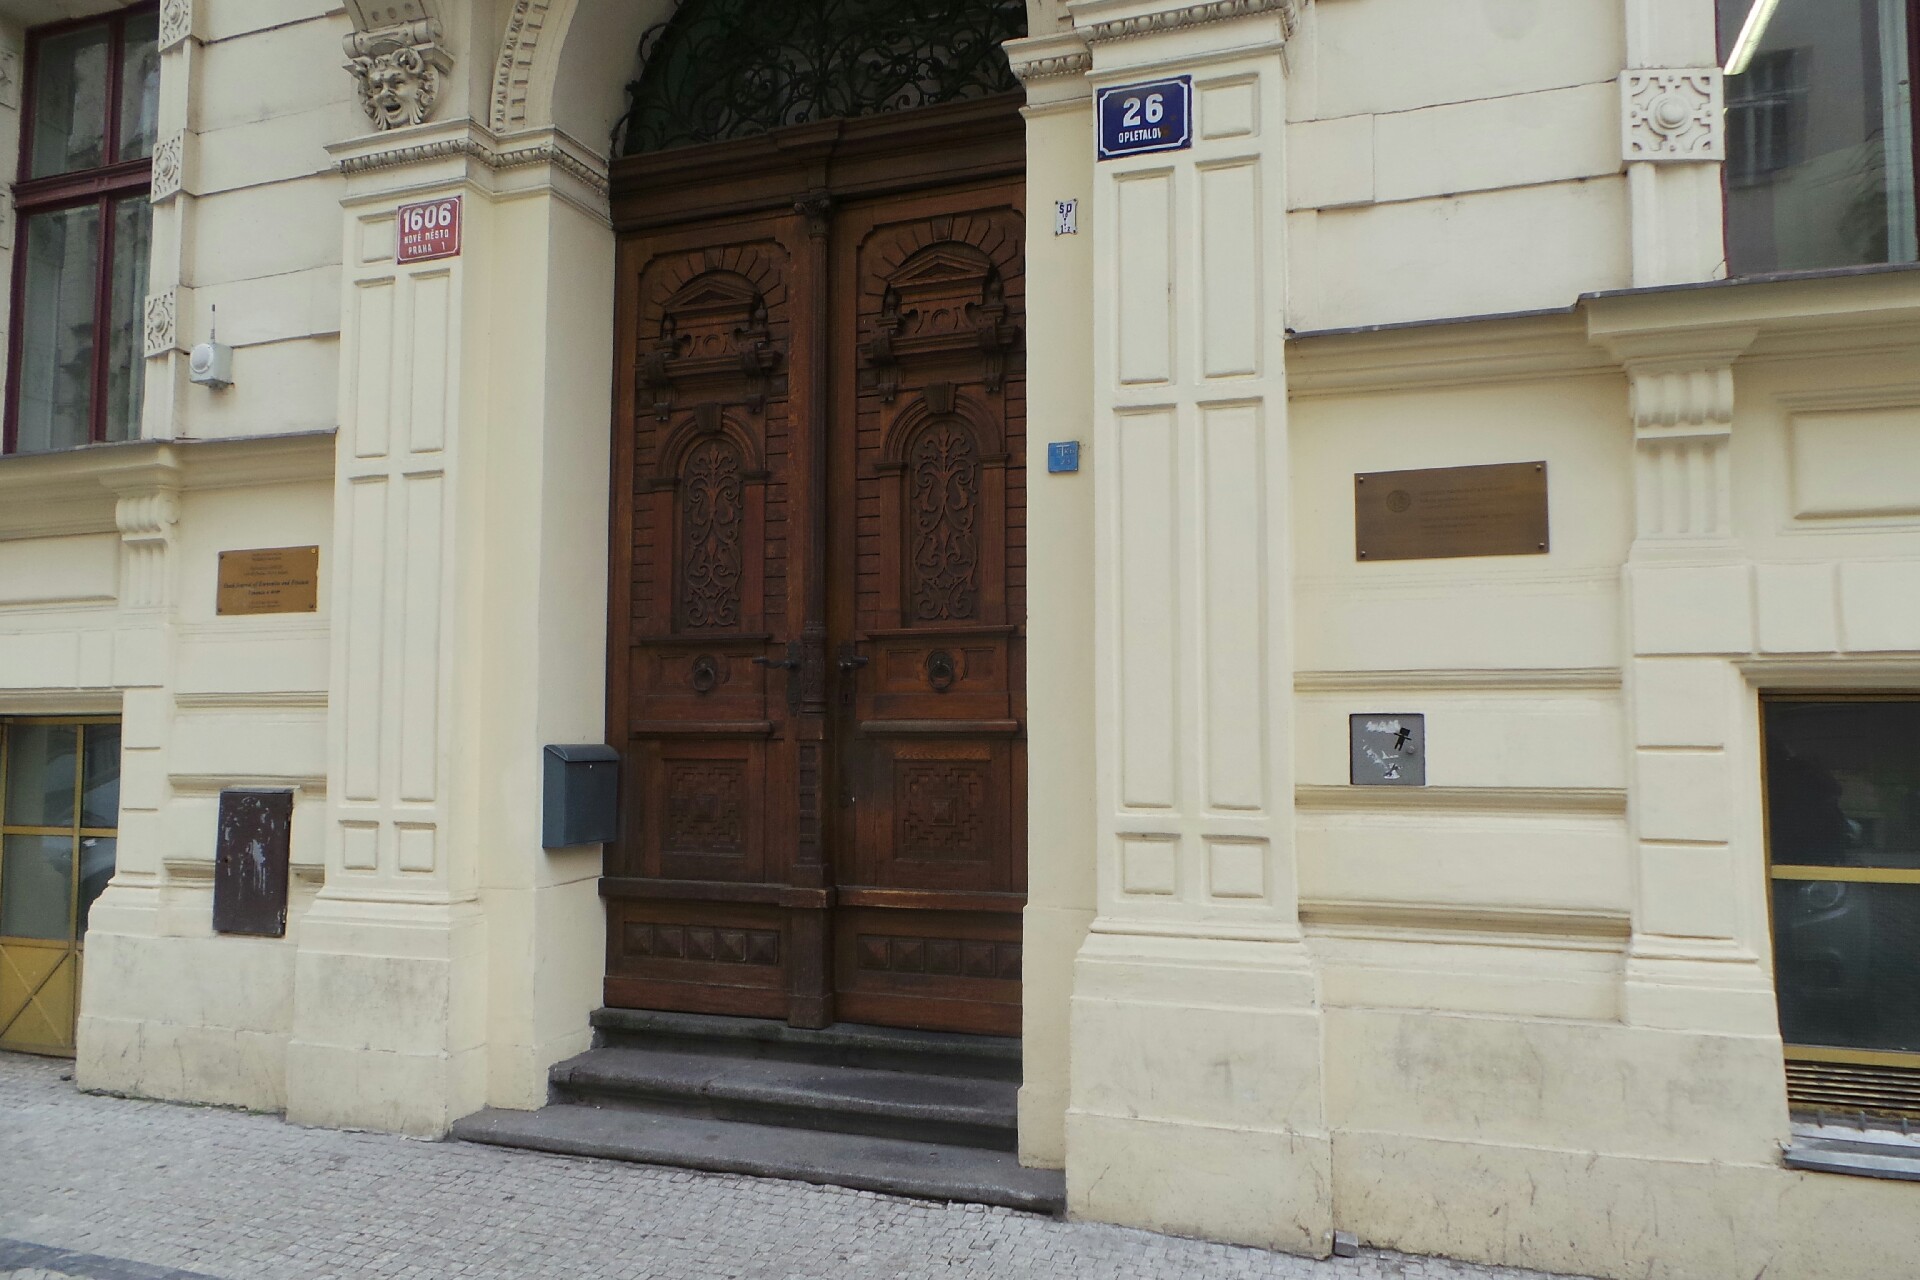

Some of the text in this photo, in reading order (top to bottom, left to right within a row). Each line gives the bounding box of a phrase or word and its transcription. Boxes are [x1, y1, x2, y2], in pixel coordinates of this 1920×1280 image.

[1123, 93, 1163, 127] 26
[1118, 127, 1165, 144] OPLETALOV
[404, 203, 451, 232] 1606
[404, 229, 449, 244] NOVÉ MĚSTO
[408, 241, 446, 255] PRAHA 1
